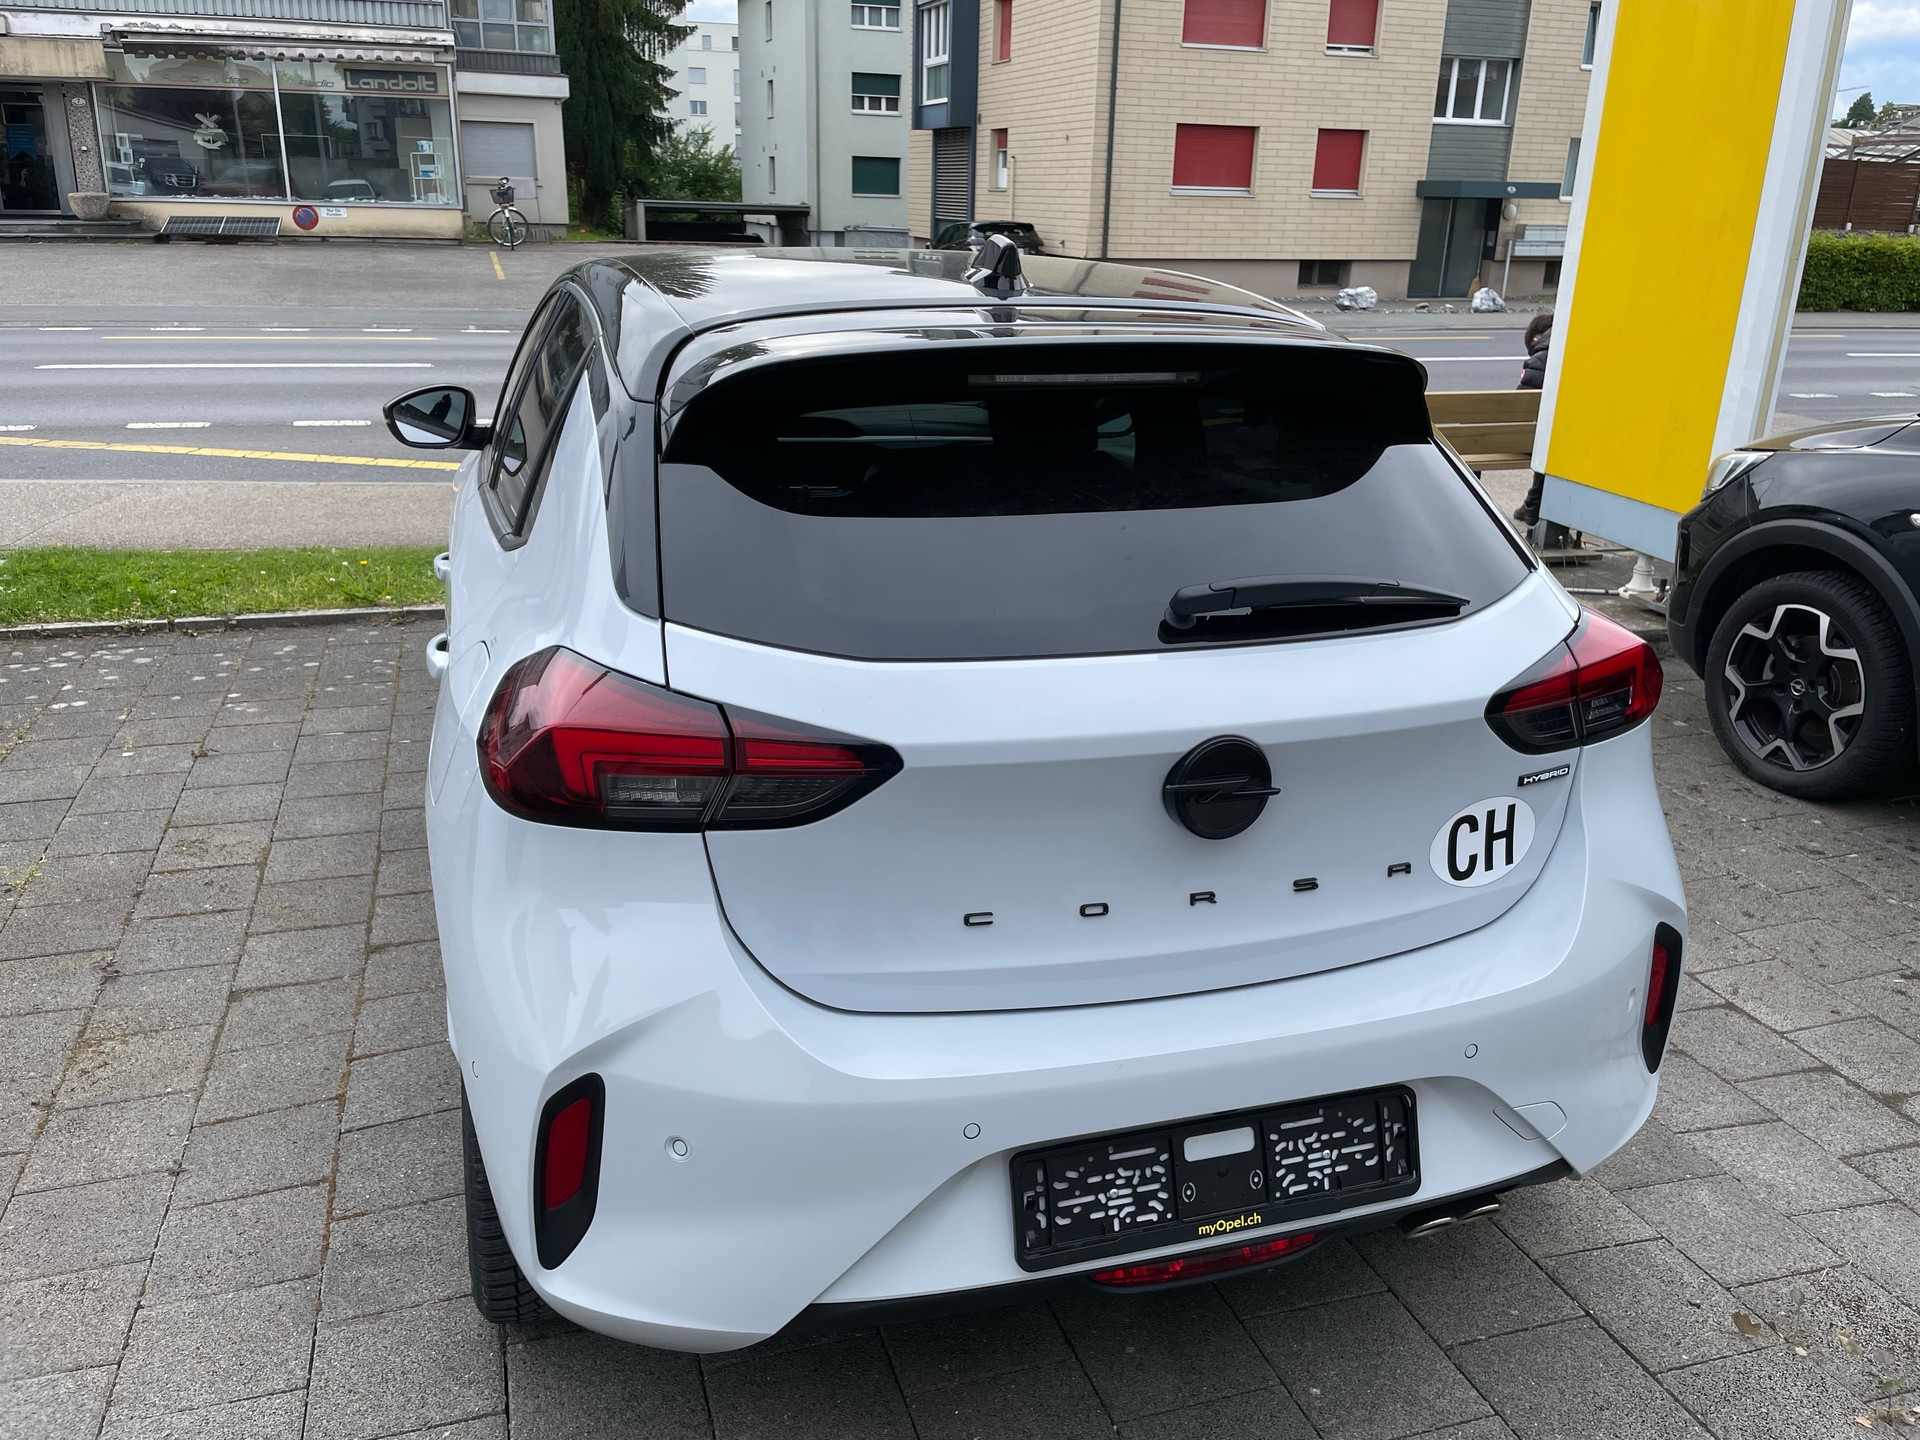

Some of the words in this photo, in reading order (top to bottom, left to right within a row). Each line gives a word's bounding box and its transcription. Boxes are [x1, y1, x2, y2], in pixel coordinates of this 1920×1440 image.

[345, 70, 436, 91] Landolt
[1523, 767, 1569, 785] HYBRID
[1447, 803, 1516, 881] CH
[963, 861, 1412, 927] CORSA
[1198, 1212, 1262, 1236] myOpel.ch
